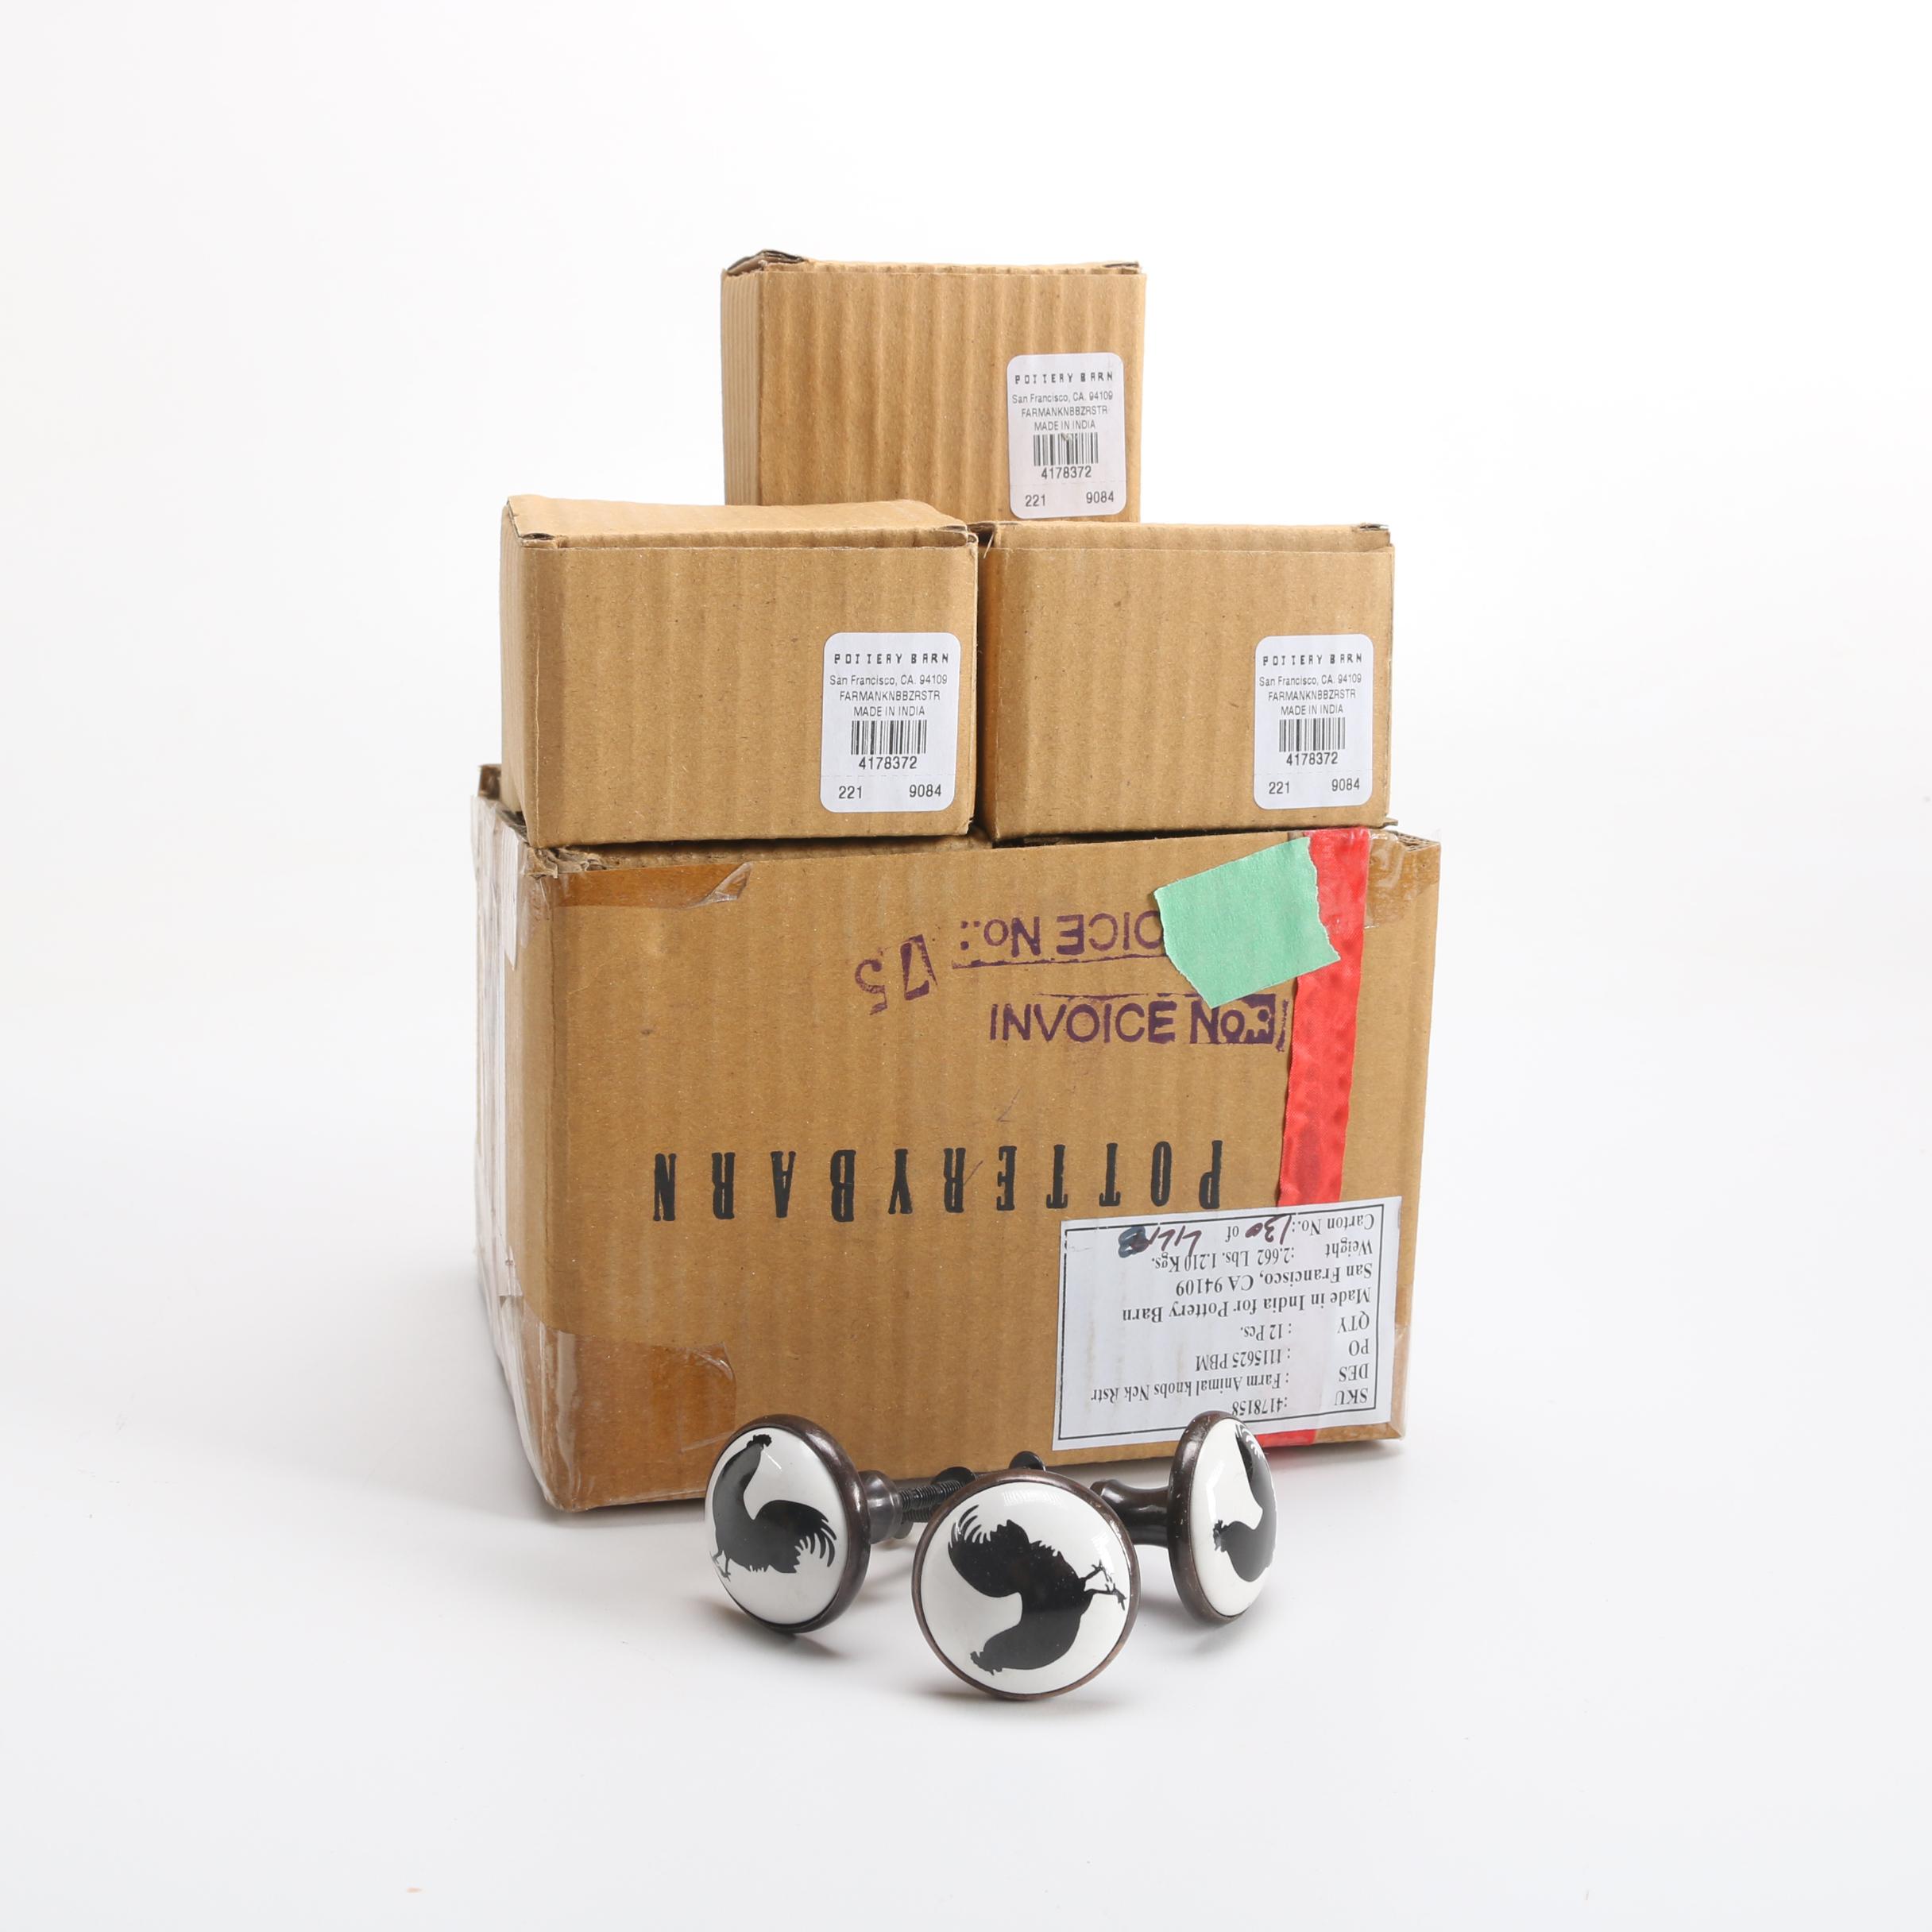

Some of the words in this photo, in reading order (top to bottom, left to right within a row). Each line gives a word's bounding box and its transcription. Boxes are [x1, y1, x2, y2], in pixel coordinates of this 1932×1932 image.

[1015, 373, 1073, 384] POTTERY
[1080, 372, 1113, 382] BARN
[1012, 395, 1028, 404] San
[1030, 393, 1070, 403] Francisco,
[1089, 391, 1113, 400] 94109
[1034, 421, 1058, 431] MADE
[1072, 419, 1095, 429] INDIA
[1041, 466, 1092, 479] 4178372
[1026, 495, 1046, 507] 221
[1086, 491, 1114, 503] 9084
[834, 654, 902, 664] POTTERY
[911, 653, 949, 663] BARN
[1263, 655, 1323, 666] POTTERY
[1330, 653, 1362, 663] BARN
[829, 675, 848, 686] San
[851, 675, 897, 686] Francisco,
[920, 674, 948, 684] 94109
[1259, 677, 1275, 686] San
[1278, 675, 1319, 686] Francisco,
[1338, 674, 1362, 683] 94109
[854, 706, 882, 717] MADE
[885, 706, 895, 716] IN
[898, 706, 925, 716] INDIA
[1281, 705, 1306, 715] MADE
[1308, 705, 1317, 714] IN
[1320, 705, 1343, 713] INDIA
[859, 756, 918, 770] 4178372
[1286, 752, 1338, 766] 4178372
[839, 786, 862, 798] 221
[909, 784, 941, 797] 9084
[1269, 782, 1290, 794] 221
[1331, 778, 1360, 791] 9084
[1056, 911, 1161, 956] OICE
[990, 1000, 1177, 1043] INVOICE
[1327, 1213, 1374, 1231] Carton
[1225, 1225, 1239, 1242] of
[1325, 1238, 1372, 1258] Weight
[1151, 1252, 1180, 1272] Kgs.
[1222, 1251, 1250, 1268] Lbs.
[1259, 1267, 1340, 1287] Francisco,
[1346, 1263, 1372, 1280] San
[1175, 1277, 1223, 1296] 94109
[1228, 1274, 1254, 1289] CA
[1310, 1293, 1325, 1312] in
[1331, 1287, 1371, 1306] Made
[1169, 1300, 1228, 1326] Pottery
[1233, 1300, 1257, 1320] for
[1263, 1296, 1305, 1316] India
[1122, 1307, 1162, 1323] Barn
[1337, 1311, 1370, 1332] QTY
[1240, 1324, 1265, 1343] Pcs.
[1269, 1323, 1284, 1340] 12
[1348, 1338, 1370, 1356] PO
[1196, 1354, 1228, 1370] PBM
[1231, 1349, 1281, 1370] 1115625
[1339, 1363, 1369, 1381] DES
[1196, 1377, 1242, 1396] Animal
[1246, 1373, 1281, 1390] Farm
[1090, 1388, 1119, 1404] Rstr
[1124, 1385, 1150, 1402] Nck
[1153, 1381, 1192, 1401] knobs
[1335, 1388, 1368, 1405] SKU
